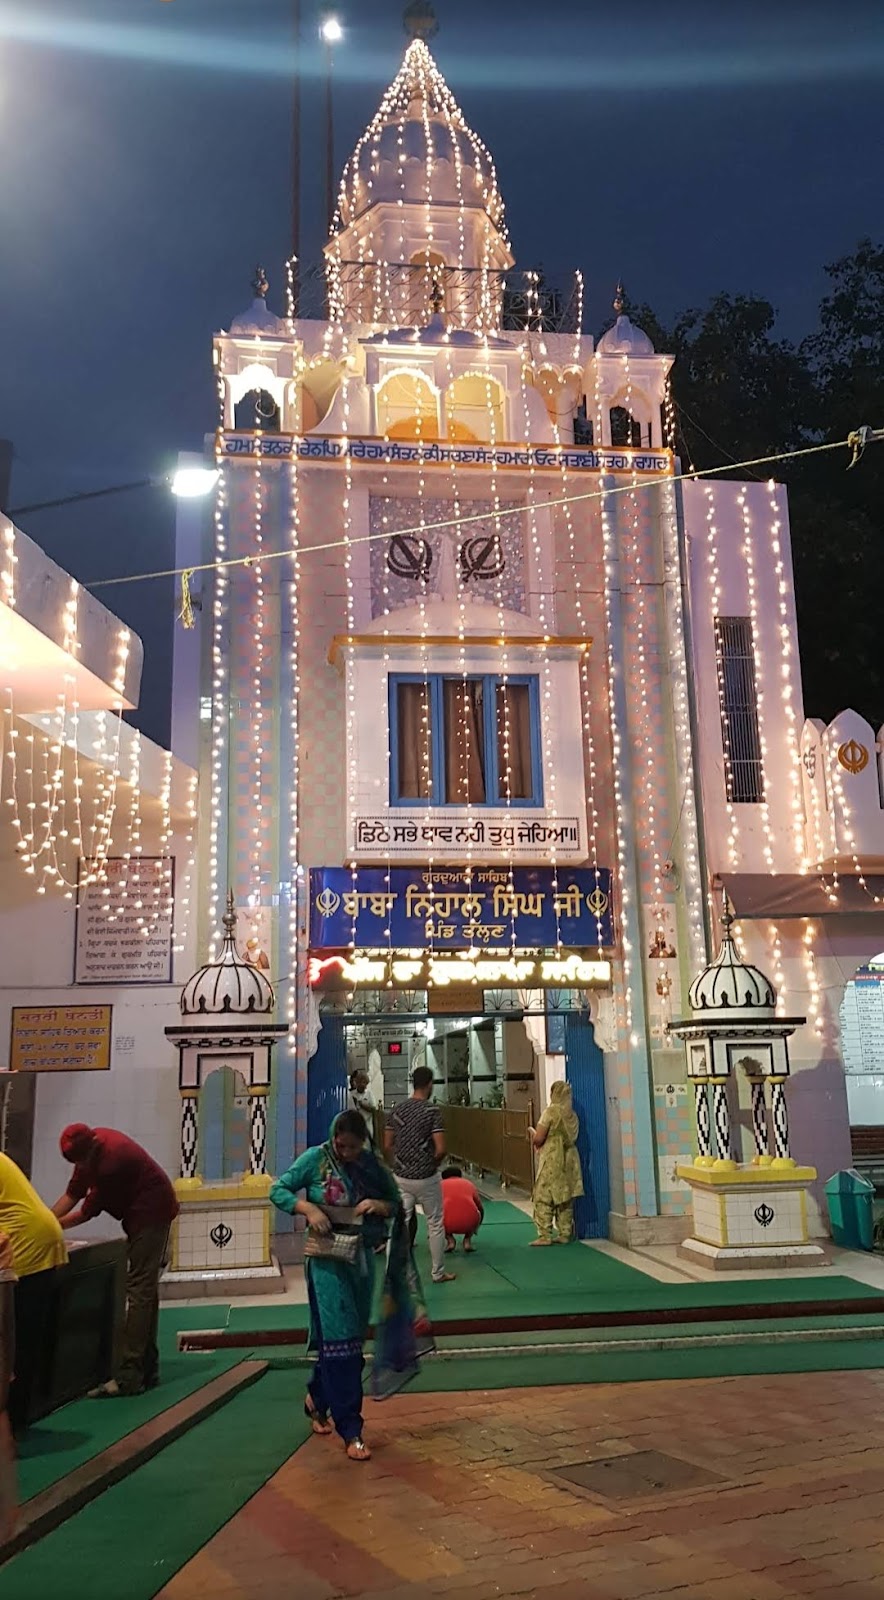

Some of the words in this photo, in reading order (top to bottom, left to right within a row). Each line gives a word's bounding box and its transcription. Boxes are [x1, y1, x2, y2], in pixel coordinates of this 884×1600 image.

[358, 821, 391, 842] ਡਿਠੇ
[393, 821, 418, 842] ਸਭੇ
[455, 821, 485, 843] ਨਹੀ
[488, 826, 515, 846] ਤੁਧੁ
[421, 871, 475, 885] ਗੁਰਦੁਆਰਾ
[478, 869, 508, 882] ਸਾਹਿਬ
[342, 892, 398, 917] ਬਾਬਾ
[406, 884, 486, 917] ਨਿਹਾਲ
[553, 884, 584, 917] ਜੀ
[425, 919, 457, 938] ਪਿੰਡ
